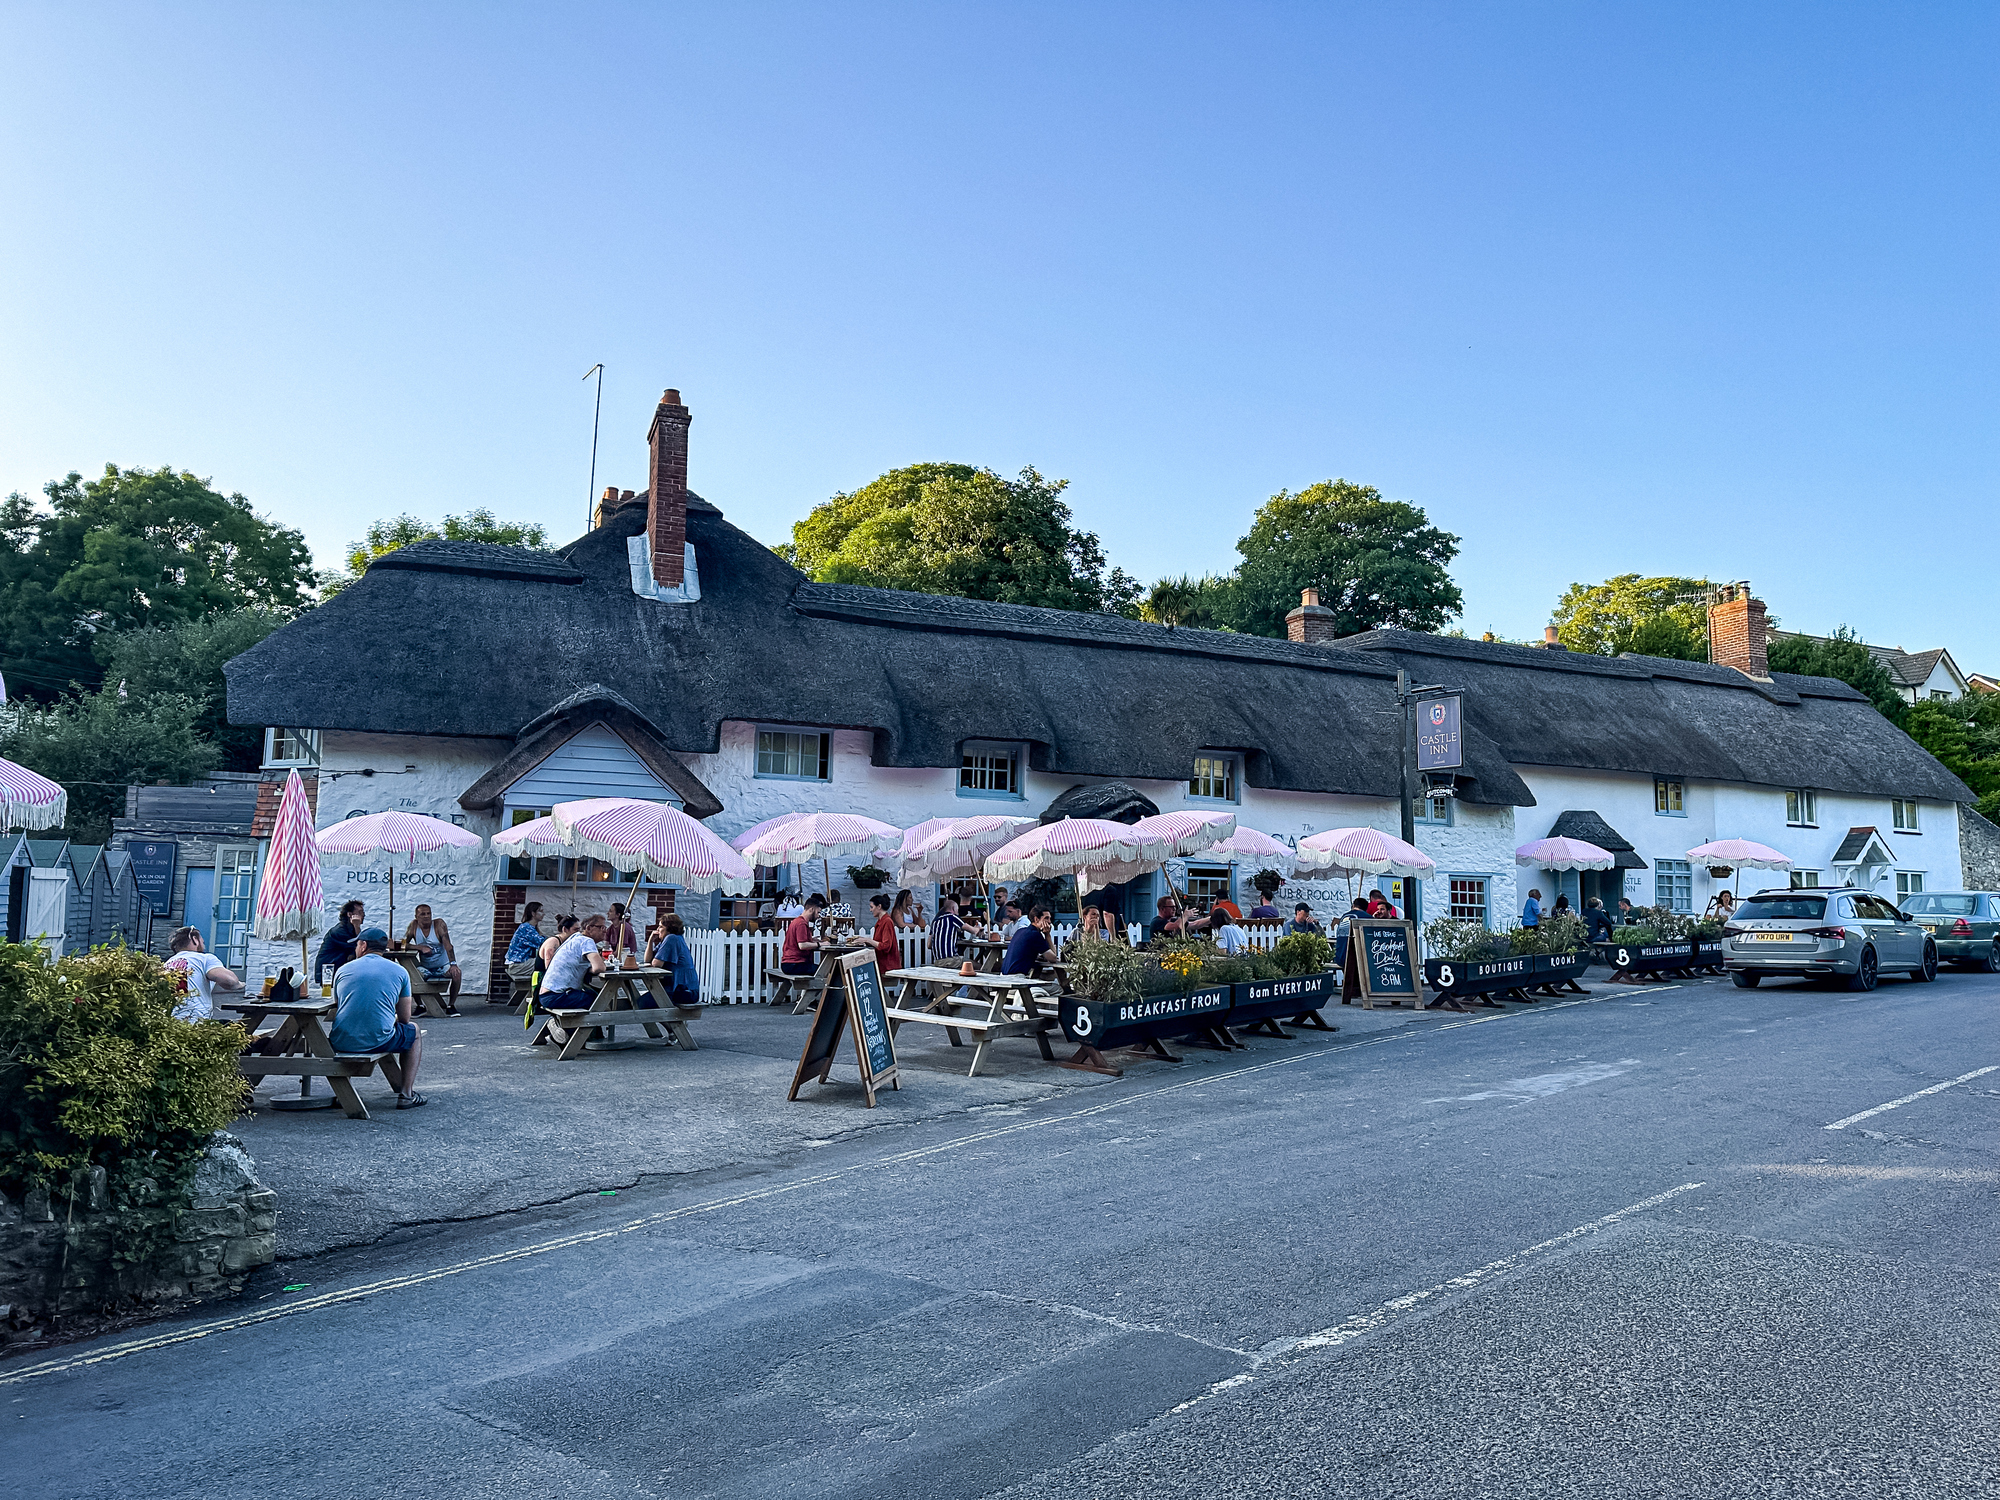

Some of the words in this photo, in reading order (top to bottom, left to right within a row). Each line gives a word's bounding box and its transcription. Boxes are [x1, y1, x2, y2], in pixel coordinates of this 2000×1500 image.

[1420, 732, 1457, 746] CASTLE
[1430, 744, 1448, 755] INN
[399, 798, 418, 807] The
[1302, 824, 1314, 832] The
[346, 871, 378, 884] PUB
[382, 872, 394, 884] &
[399, 872, 457, 886] ROOMS
[1625, 877, 1641, 885] STLE
[1296, 888, 1303, 899] &
[1307, 890, 1345, 901] ROOMS
[1371, 939, 1405, 954] Breakfast
[1641, 947, 1662, 956] WELLIES
[1662, 946, 1674, 955] AND
[1675, 945, 1691, 954] MUDDY
[1700, 944, 1711, 952] PAWS
[1373, 951, 1403, 965] Daily
[1550, 955, 1576, 967] ROOMS
[1615, 948, 1630, 966] B
[1479, 960, 1523, 975] BOUTIQUE
[1437, 965, 1455, 987] B
[1249, 986, 1270, 999] 8am
[1274, 982, 1302, 996] EVERY
[1305, 979, 1322, 992] DAY
[1120, 998, 1186, 1020] BREAKFAST
[1191, 993, 1220, 1009] FROM
[1072, 1006, 1093, 1036] B
